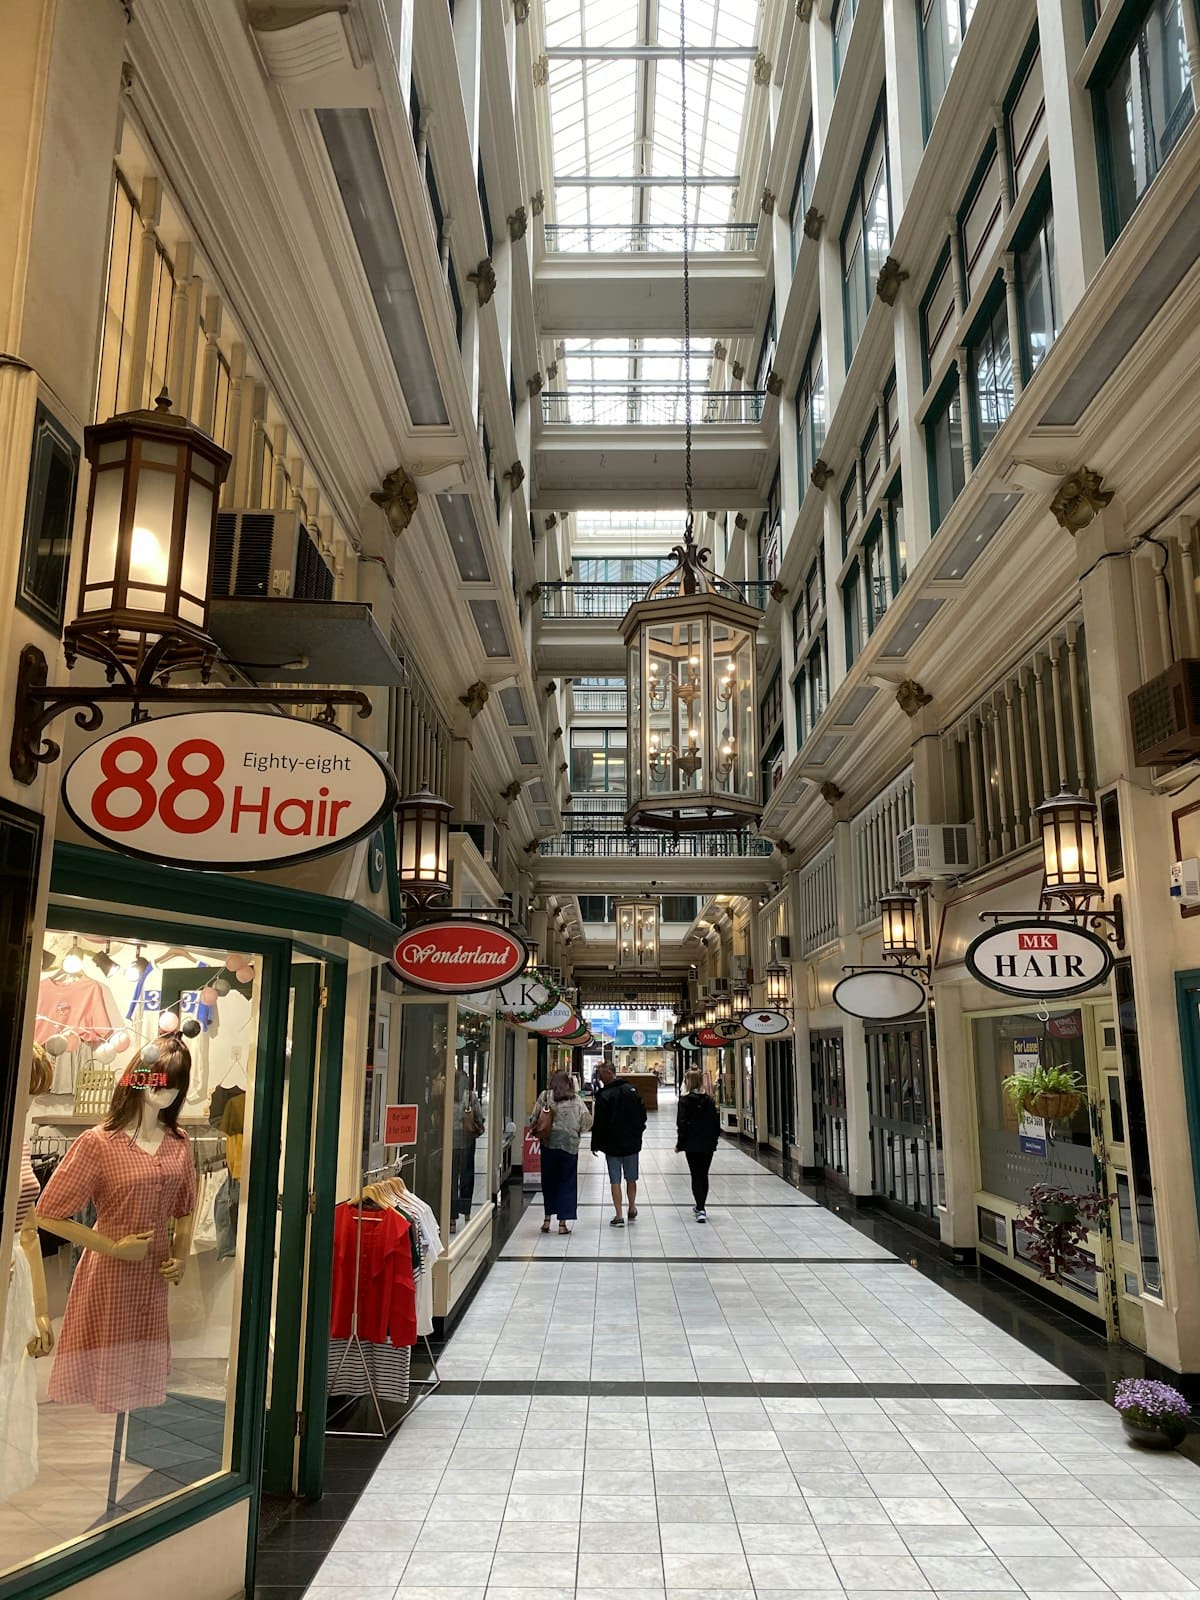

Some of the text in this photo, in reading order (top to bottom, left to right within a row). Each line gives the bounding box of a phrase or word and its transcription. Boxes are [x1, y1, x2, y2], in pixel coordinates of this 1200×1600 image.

[243, 752, 352, 773] Eighty-eight
[91, 736, 352, 837] 88 Hair
[1022, 935, 1054, 949] MK
[402, 944, 511, 965] Wonderland
[993, 954, 1087, 977] HAIR
